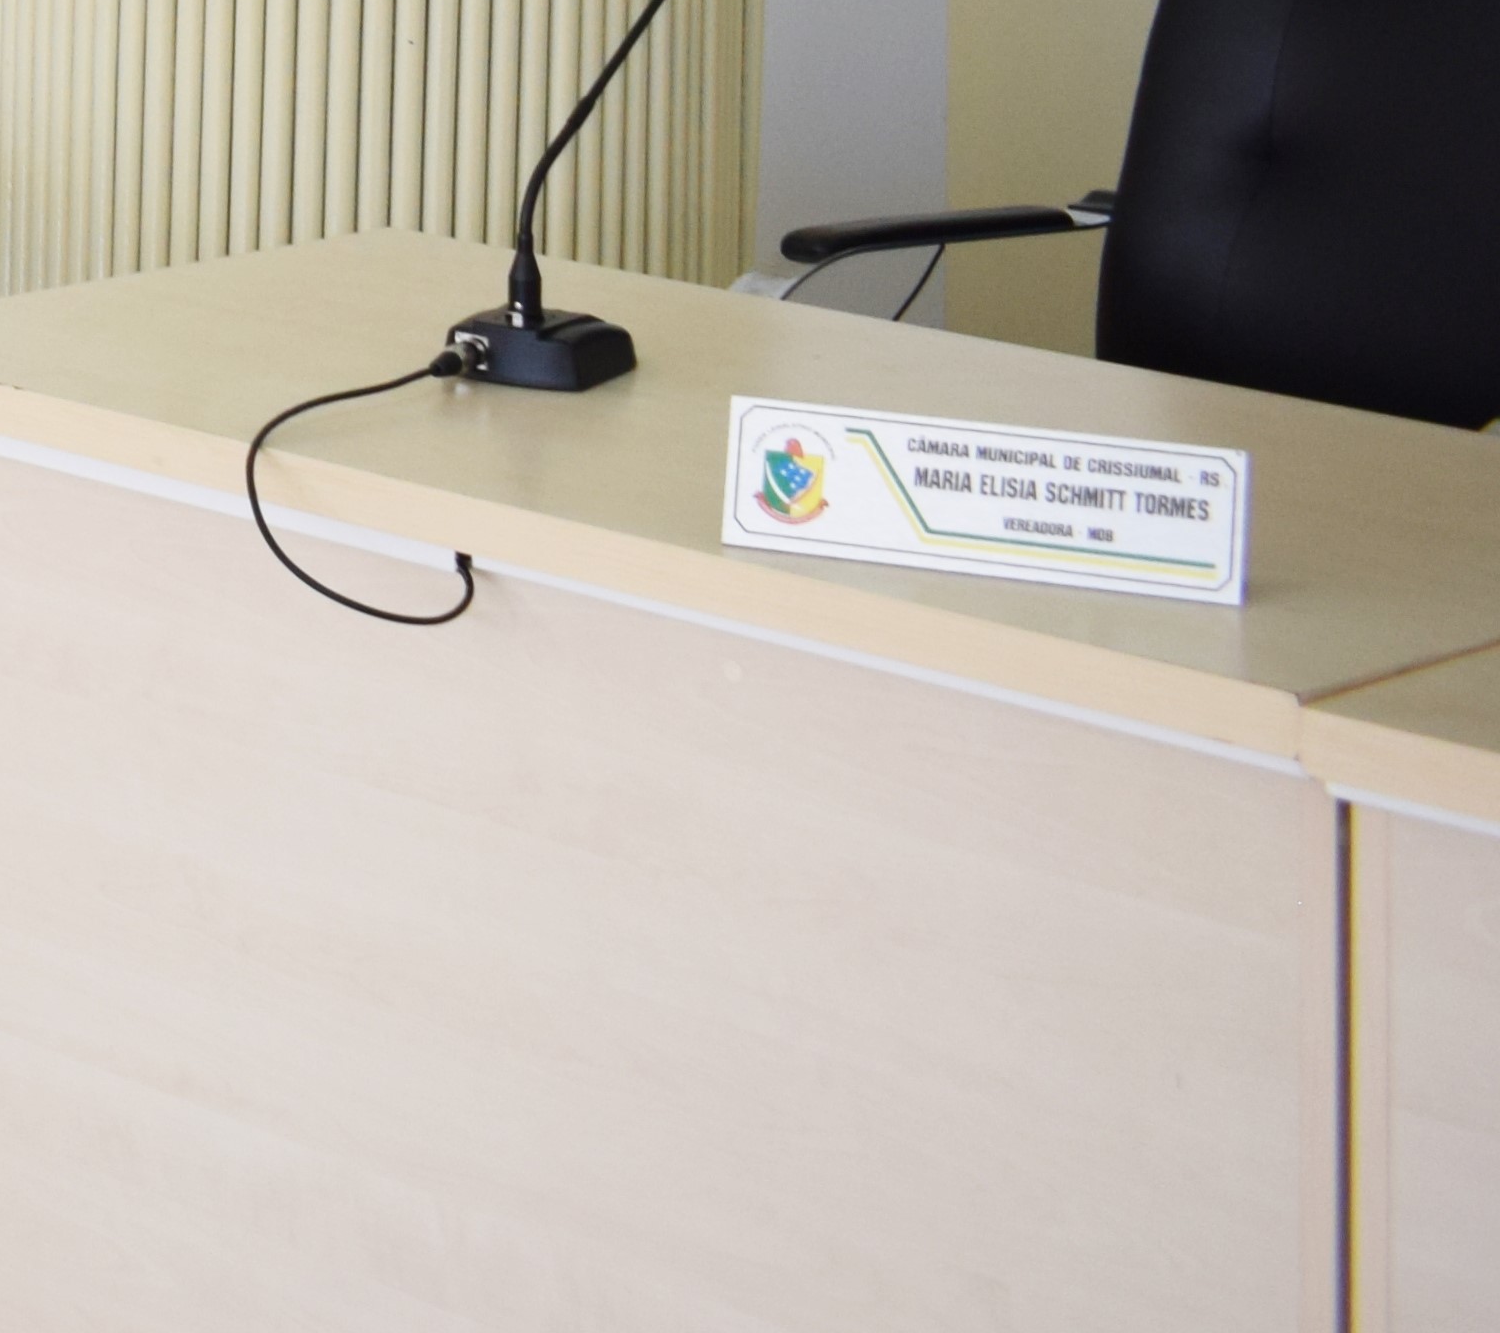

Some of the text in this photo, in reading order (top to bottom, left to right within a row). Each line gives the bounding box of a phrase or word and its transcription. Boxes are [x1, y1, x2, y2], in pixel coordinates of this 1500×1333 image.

[907, 436, 970, 458] CÂMARA
[976, 445, 1057, 469] MUNICIPAL
[1063, 455, 1081, 471] DE
[1087, 458, 1182, 484] CRISSIUMAL
[1199, 470, 1222, 487] RS
[913, 466, 1211, 522] MARIA ELISIA SCHMITT TORMES
[1003, 517, 1074, 538] VEREADORA
